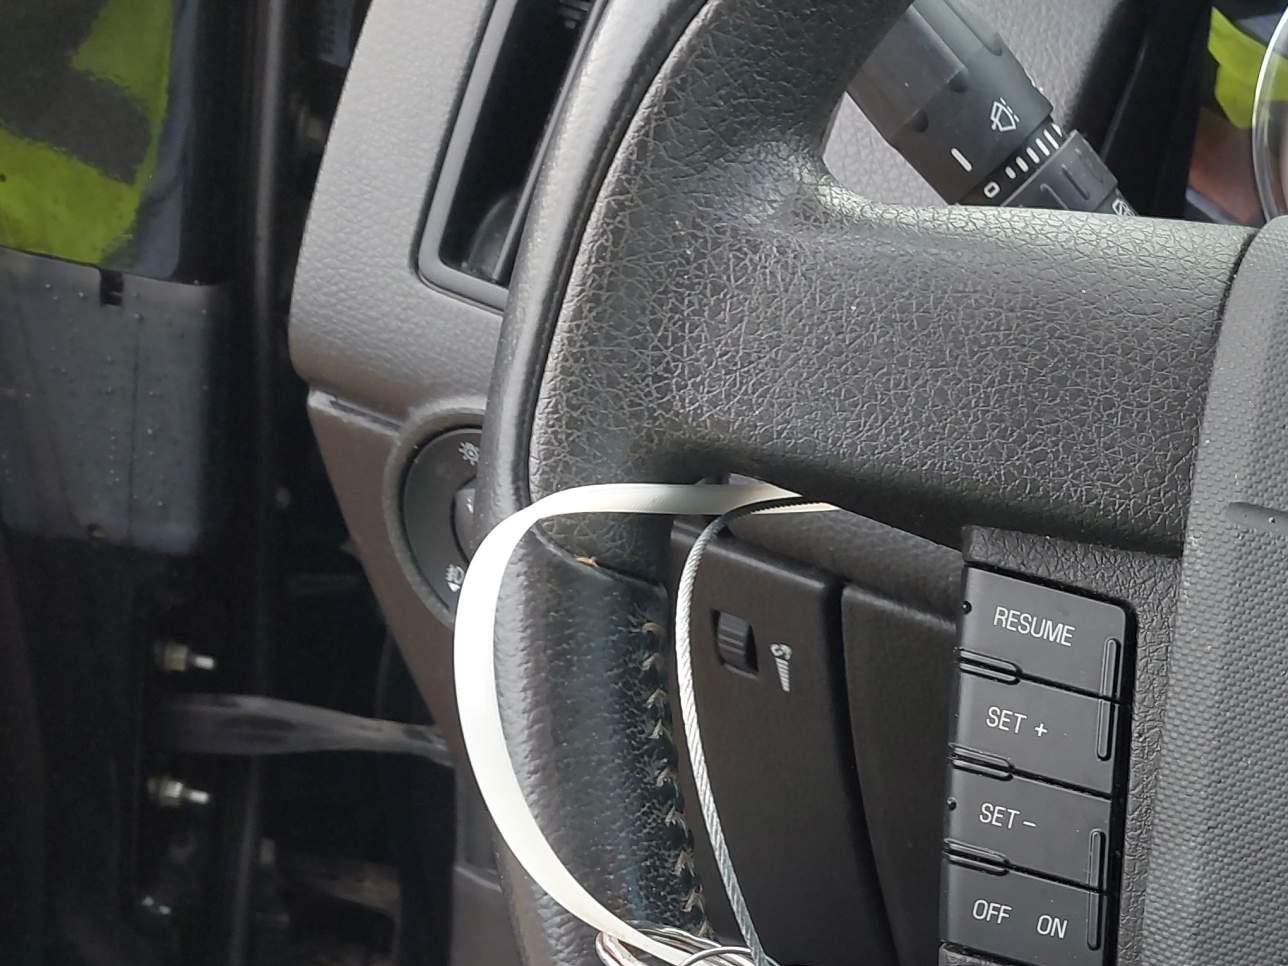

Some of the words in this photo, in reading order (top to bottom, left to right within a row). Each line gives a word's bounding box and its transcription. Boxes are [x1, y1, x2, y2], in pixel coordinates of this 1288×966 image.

[993, 606, 1076, 646] RESUME
[985, 706, 1027, 734] SET
[972, 899, 1012, 925] OFF
[1036, 914, 1067, 939] ON
